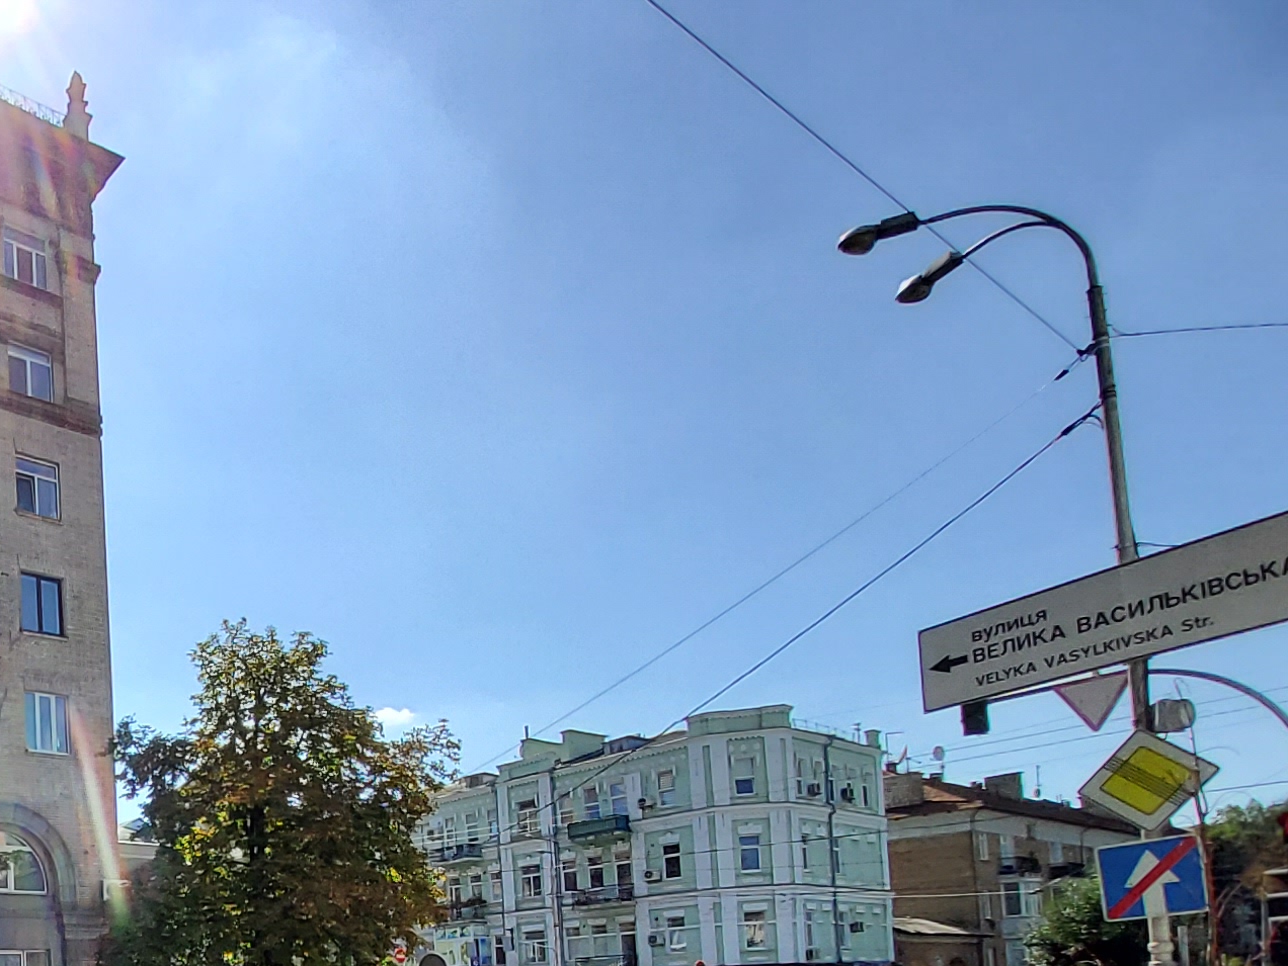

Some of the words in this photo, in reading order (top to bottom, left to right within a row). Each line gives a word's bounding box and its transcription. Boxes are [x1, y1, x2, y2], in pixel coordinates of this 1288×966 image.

[971, 609, 1048, 643] вулиця
[973, 625, 1066, 663] ВЕЛИКА
[975, 662, 1037, 687] VELYKA
[1044, 625, 1174, 668] VASYLKIVSKA
[1181, 616, 1214, 632] Str.
